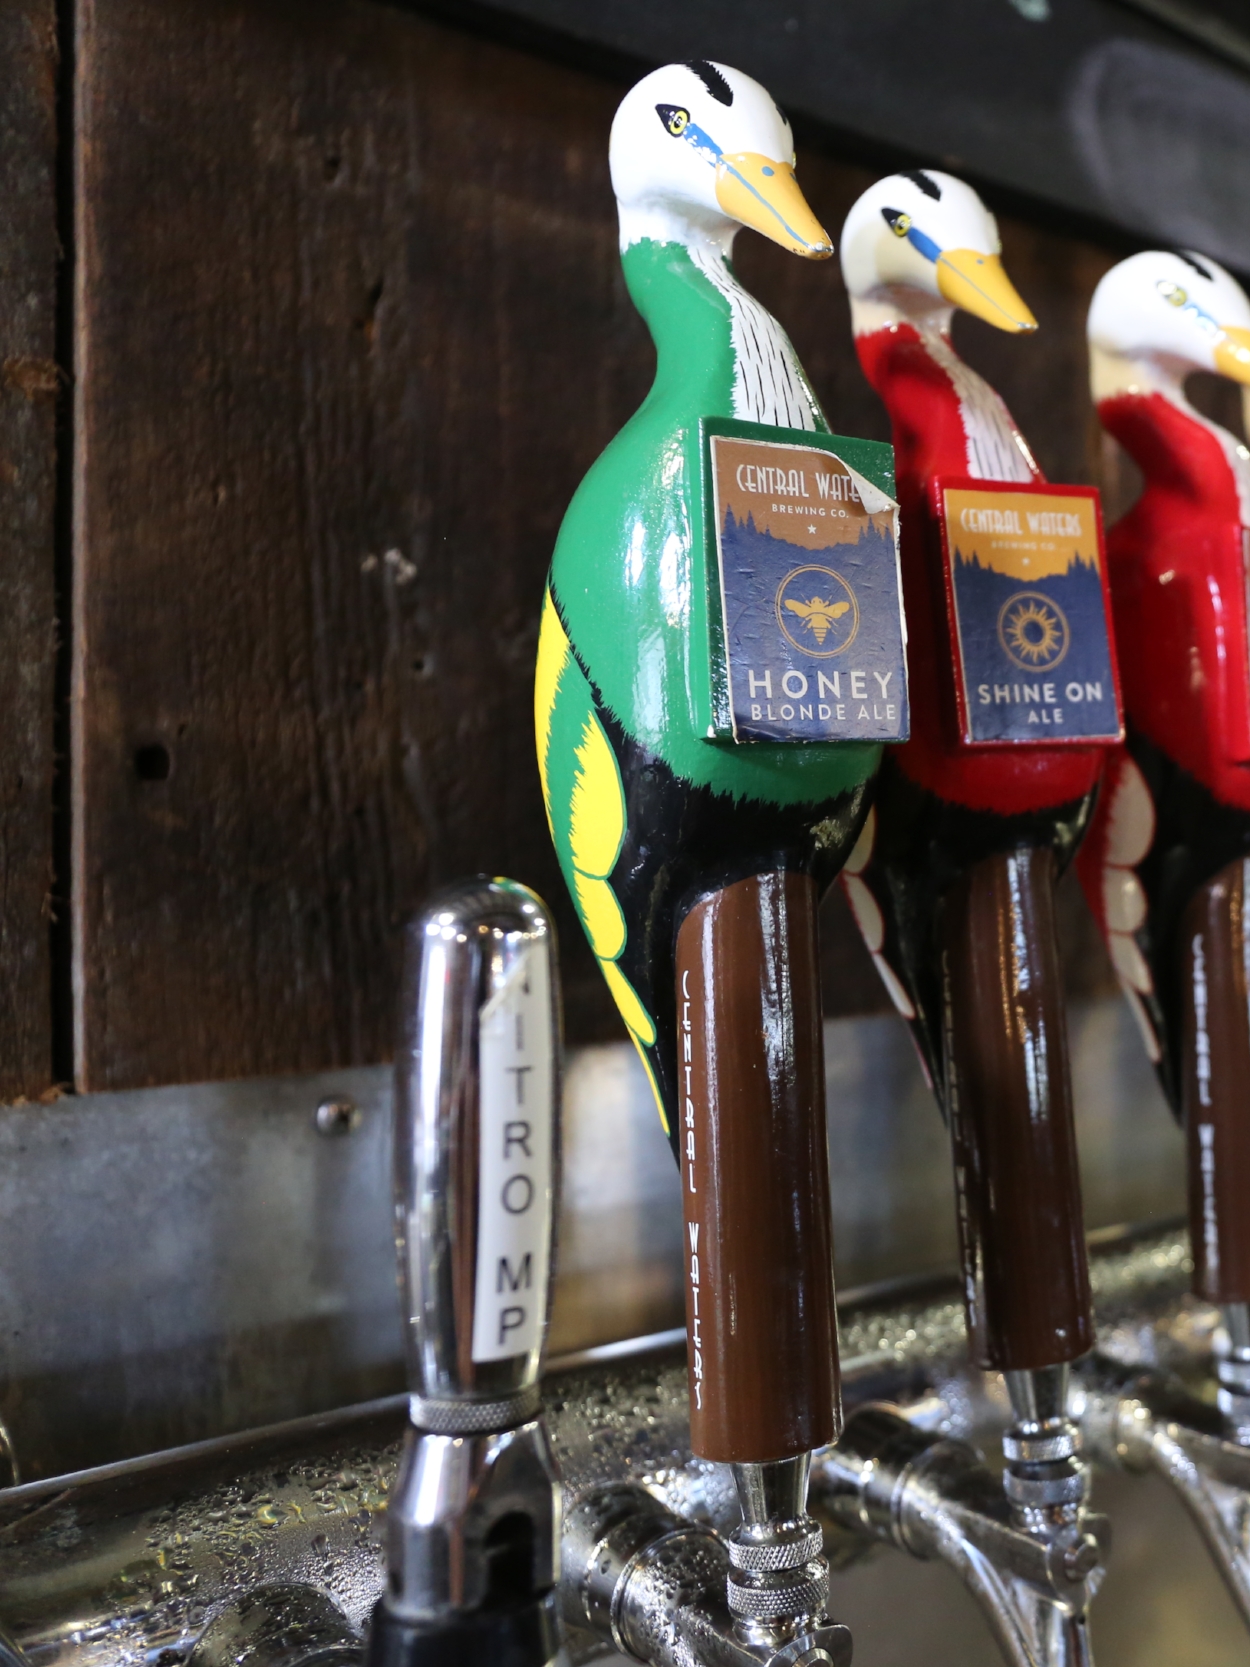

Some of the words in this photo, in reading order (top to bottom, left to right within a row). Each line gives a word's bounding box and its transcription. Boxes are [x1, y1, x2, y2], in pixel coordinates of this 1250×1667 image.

[736, 464, 810, 498] CENTRAL
[815, 472, 862, 503] WATE
[771, 503, 826, 517] BREWING
[830, 509, 850, 519] CO.
[960, 508, 1024, 536] CENTRAL
[1025, 511, 1083, 538] WATERS
[748, 669, 892, 699] HONEY
[977, 682, 1058, 705] SHINE
[1065, 681, 1103, 703] ON
[751, 704, 847, 721] BLONDE
[857, 704, 896, 720] ALE
[1027, 707, 1064, 724] ALE
[500, 955, 535, 1216] ITRO
[682, 970, 697, 1194] CENTRAL
[688, 1221, 704, 1410] WATERS
